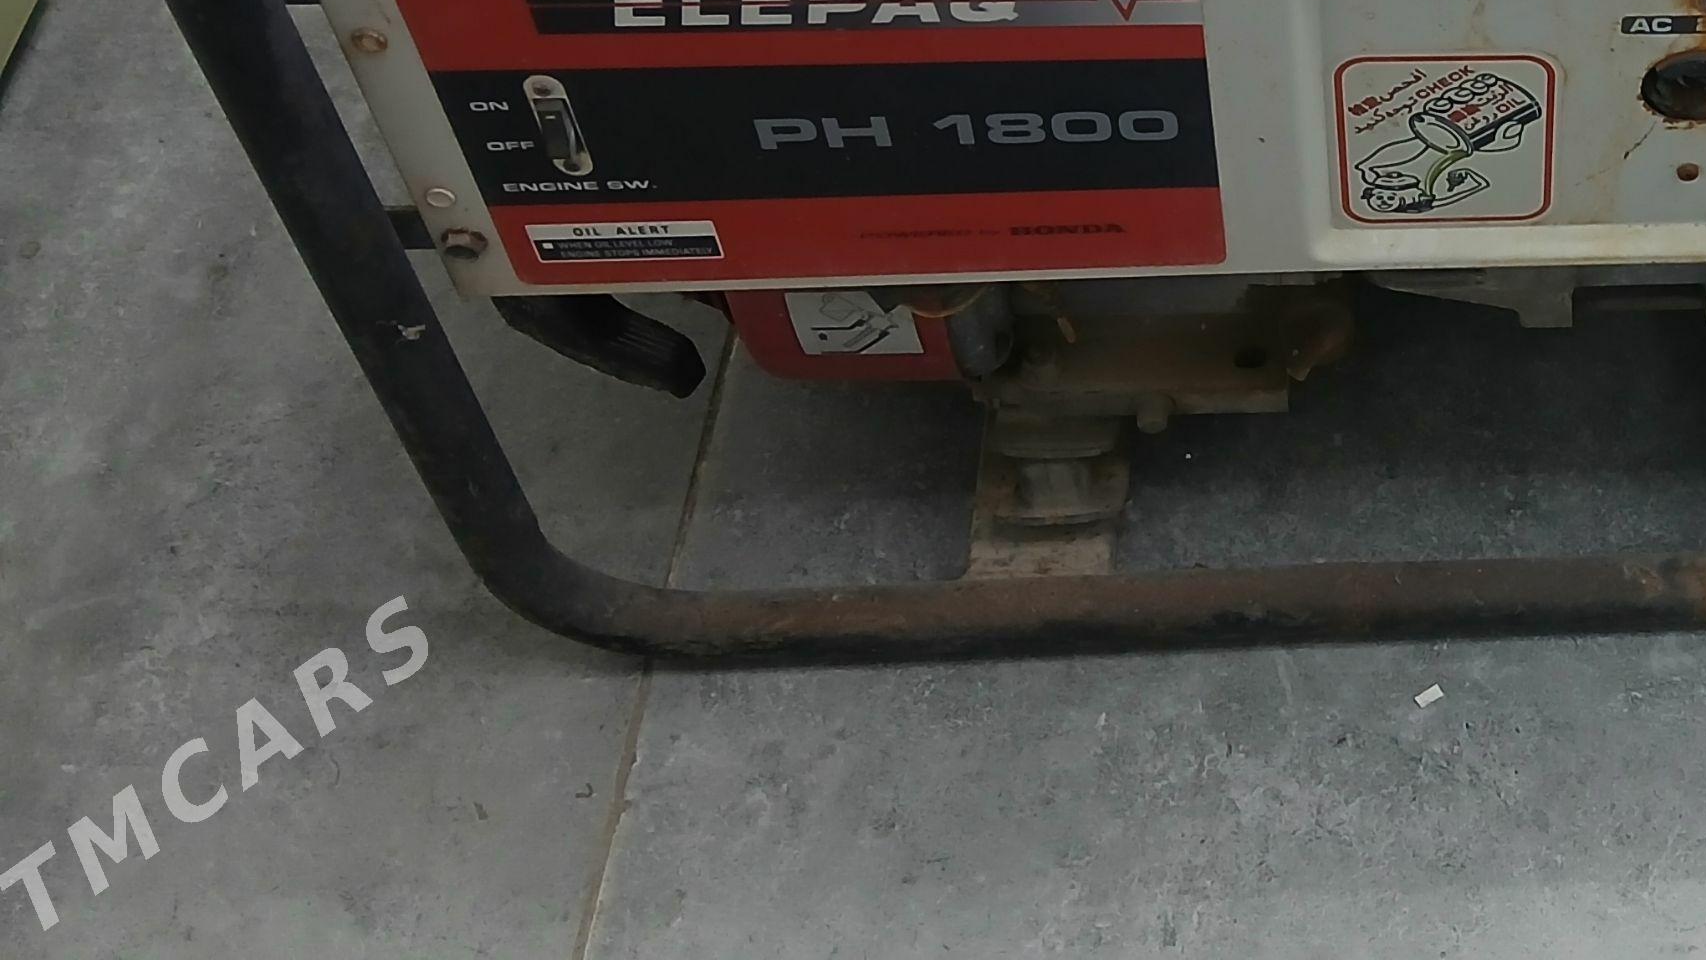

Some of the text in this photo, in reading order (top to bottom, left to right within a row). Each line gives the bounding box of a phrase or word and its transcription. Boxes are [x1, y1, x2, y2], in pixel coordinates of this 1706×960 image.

[1629, 17, 1672, 32] AC
[1415, 65, 1476, 100] CHECK
[469, 101, 510, 111] ON
[1495, 96, 1527, 114] OIL
[753, 110, 1180, 150] PH 1800
[486, 140, 535, 151] OFF
[502, 181, 600, 192] ENGINE
[572, 225, 670, 237] OIL ALERT
